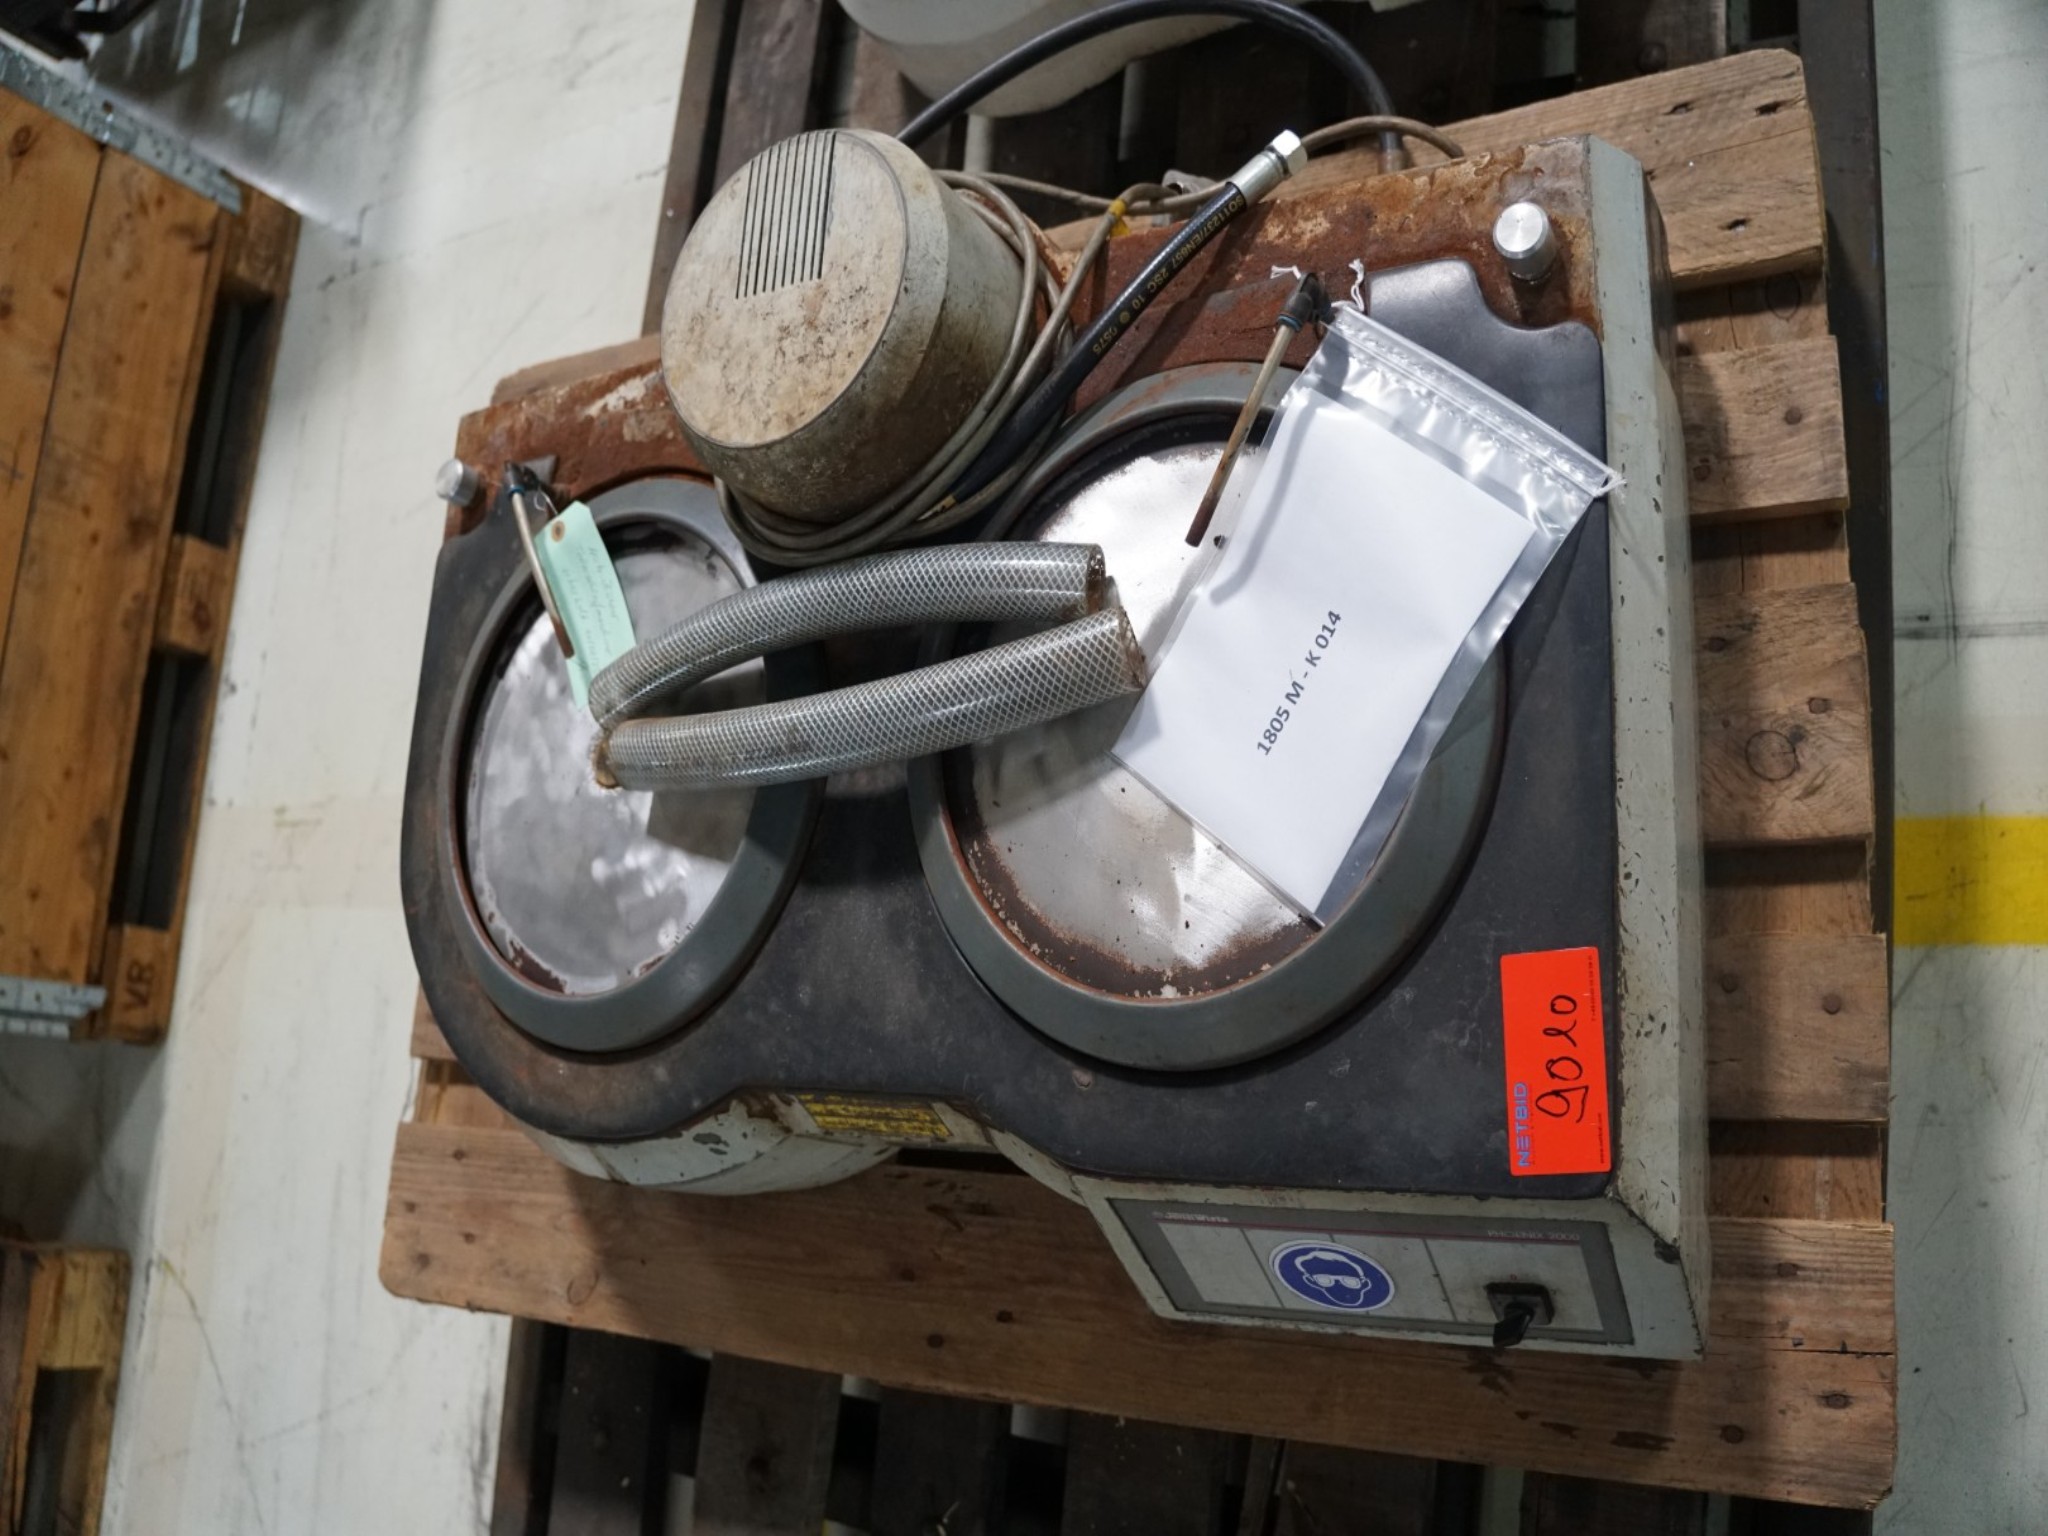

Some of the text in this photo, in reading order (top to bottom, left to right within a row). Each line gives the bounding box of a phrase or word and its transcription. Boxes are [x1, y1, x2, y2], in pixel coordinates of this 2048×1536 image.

[1131, 295, 1145, 310] 10
[1147, 267, 1169, 293] 2SC
[1257, 706, 1290, 756] 1805
[1284, 680, 1305, 705] M
[1304, 649, 1321, 667] K
[1315, 610, 1341, 649] 014
[1514, 1082, 1531, 1167] NETBID
